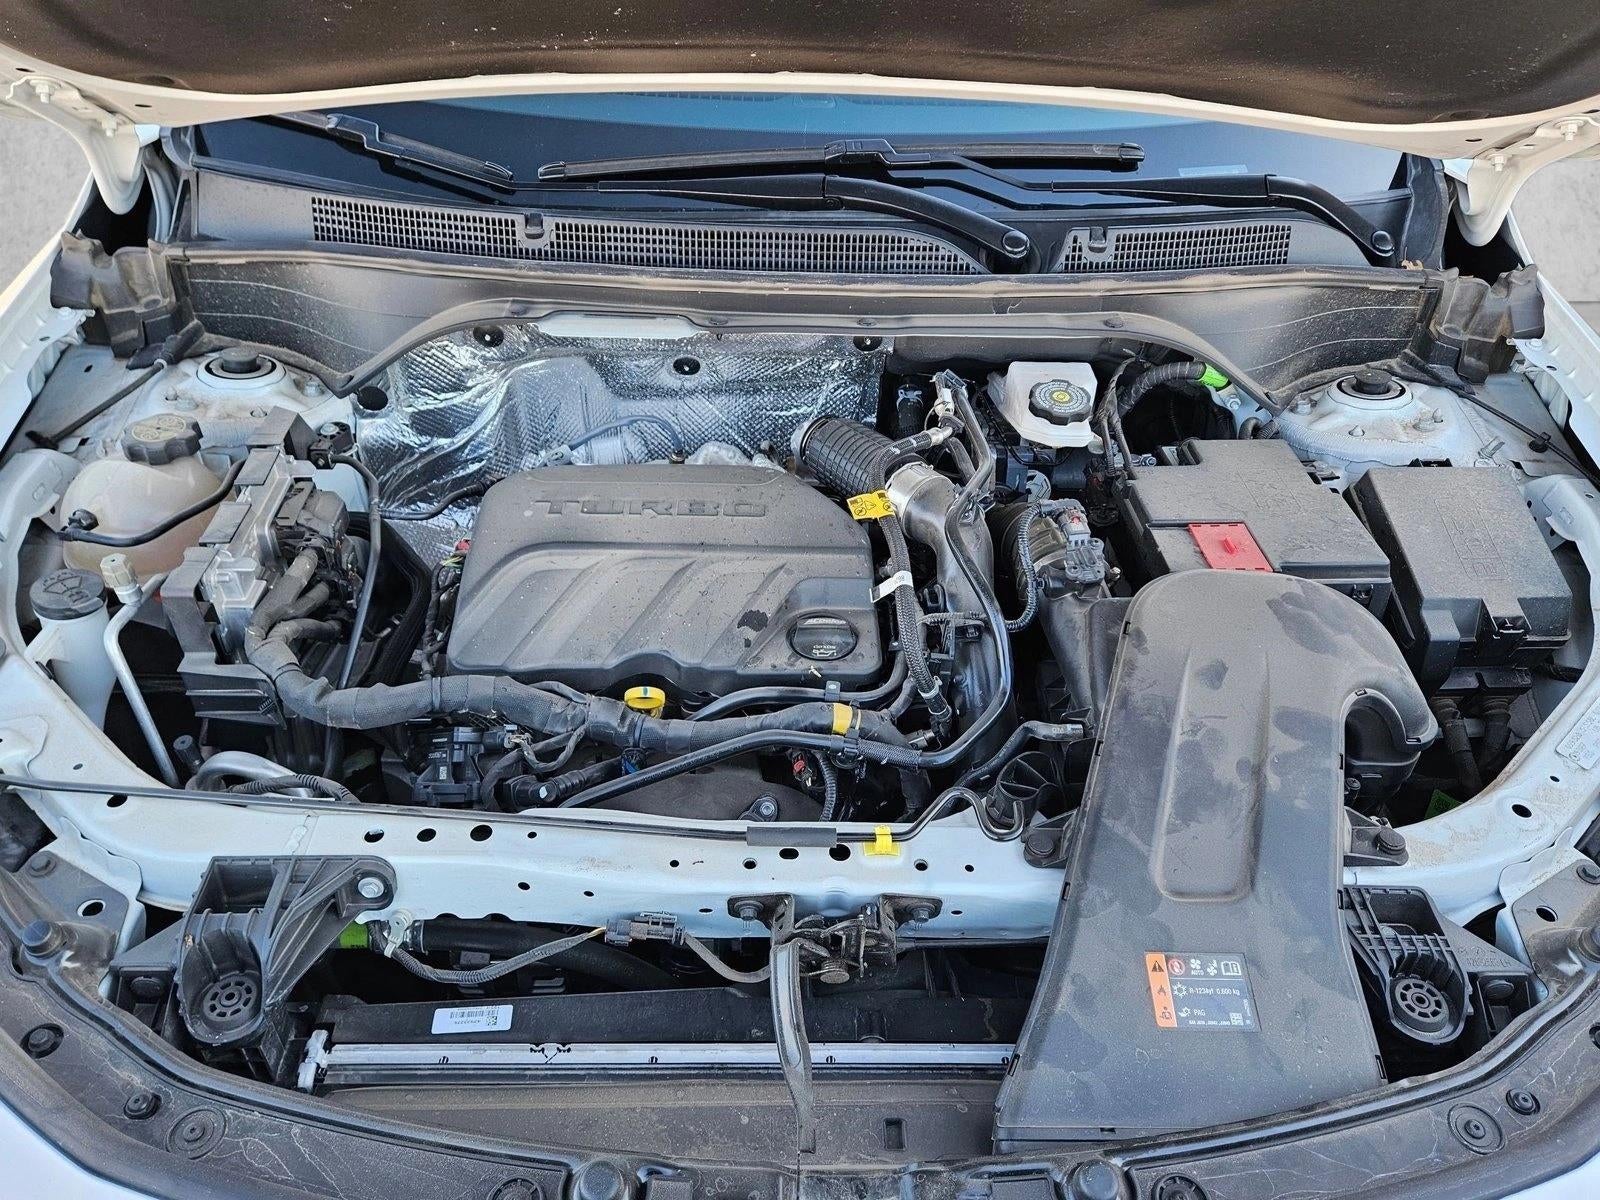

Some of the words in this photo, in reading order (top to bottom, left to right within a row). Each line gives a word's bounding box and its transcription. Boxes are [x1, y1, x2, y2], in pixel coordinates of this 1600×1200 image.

[533, 500, 766, 518] TURBO
[1232, 988, 1240, 996] kg
[1193, 1009, 1206, 1017] PAG
